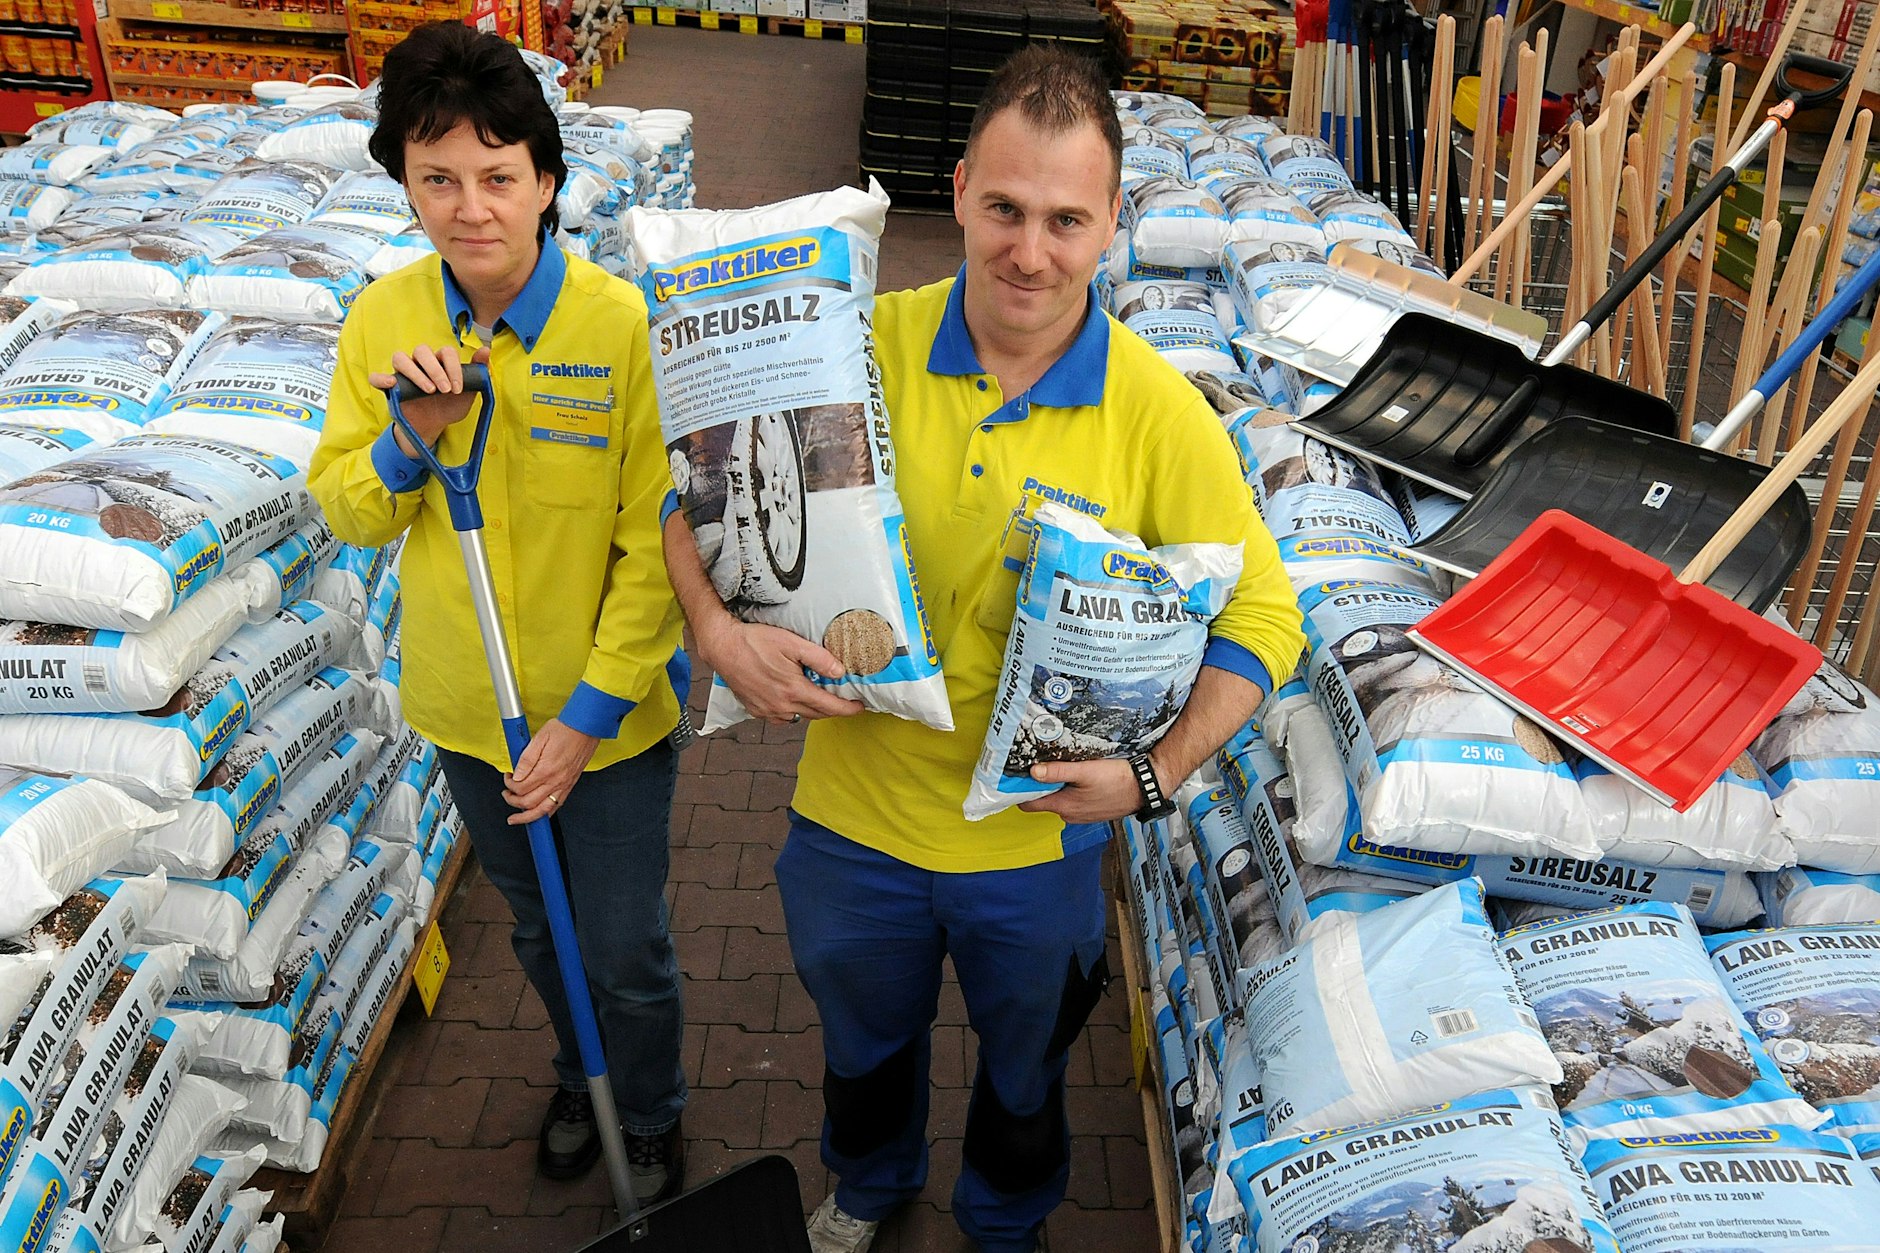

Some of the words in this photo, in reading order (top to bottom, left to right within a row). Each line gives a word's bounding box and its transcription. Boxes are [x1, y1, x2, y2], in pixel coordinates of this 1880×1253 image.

[1186, 209, 1195, 217] KG
[656, 242, 816, 298] Praktiker
[1134, 263, 1185, 280] Praktiker
[660, 293, 821, 357] STREUSALZ
[2, 319, 42, 367] GRANULAT
[663, 352, 706, 377] AUSREICHEND
[707, 346, 722, 359] FÜR
[725, 345, 739, 354] BIS
[742, 341, 753, 351] ZU
[755, 336, 777, 348] 2500
[2, 372, 86, 389] GRANUL
[531, 362, 611, 378] Praktiker
[689, 379, 712, 393] Wirkung
[713, 373, 731, 385] durch
[732, 366, 765, 379] spezielles
[766, 356, 824, 372] Mischverhältnis
[695, 368, 712, 380] gegen
[710, 387, 720, 395] bei
[721, 381, 750, 393] dickeren
[751, 378, 764, 386] Eis-
[765, 374, 780, 383] und
[781, 370, 811, 381] Schnee-
[94, 376, 149, 401] LAVA
[692, 400, 709, 411] durch
[710, 394, 728, 407] grobe
[729, 389, 756, 400] Kristalle
[175, 397, 304, 420] Praktiker
[152, 440, 272, 480] GRANULAT
[246, 491, 294, 531] GRANULAT
[1022, 476, 1107, 518] Praktiker
[27, 512, 47, 523] 20
[50, 515, 71, 529] KG
[1291, 515, 1408, 547] STREUSALZ
[175, 545, 220, 592] Praktiker
[1059, 588, 1124, 623] LAVA
[1055, 621, 1114, 639] AUSREICHEND
[1058, 637, 1118, 654] Umweltfreundlich
[0, 658, 66, 680] NULAT
[245, 665, 271, 700] LAVA
[271, 633, 317, 677] GRANULAT
[1053, 656, 1113, 674] Wiederverwertbar
[1056, 647, 1090, 662] Verringert
[27, 686, 48, 699] 20
[51, 686, 75, 700] KG
[1320, 660, 1361, 750] STREUSALZ
[201, 702, 245, 759] Praktiker
[278, 739, 302, 772] LAVA
[301, 700, 344, 749] GRANULAT
[1461, 744, 1481, 759] 25
[1485, 746, 1505, 762] KG
[1856, 762, 1875, 775] 25
[19, 787, 35, 801] 20
[35, 781, 52, 795] KG
[236, 775, 278, 834] Praktiker
[310, 768, 350, 823] GRANULAT
[1252, 801, 1292, 897] STREUSALZ
[1355, 834, 1466, 867] Praktiker
[1509, 856, 1657, 895] STREUSALZ
[1609, 893, 1627, 905] 25
[324, 932, 342, 965] LAVA
[341, 875, 377, 933] GRANULAT
[1530, 921, 1680, 956] GRANULAT
[1718, 939, 1795, 973] LAVA
[1798, 935, 1880, 951] GRAN
[1520, 961, 1537, 973] FÜR
[1539, 957, 1553, 966] BIS
[1570, 950, 1586, 958] 200
[1731, 960, 1793, 984] AUSREICHEND
[1814, 953, 1829, 961] BIS
[1741, 968, 1803, 991] Umweltfreundlich
[20, 1031, 56, 1094] LAVA
[51, 927, 115, 1032] GRANULAT
[352, 1020, 370, 1056] LAVA
[368, 959, 399, 1022] GRANULAT
[139, 1019, 152, 1043] KG
[54, 1105, 90, 1167] LAVA
[85, 998, 145, 1107] GRANULAT
[1278, 1102, 1295, 1125] KG
[1620, 1103, 1636, 1117] 10
[1638, 1103, 1655, 1115] KG
[1345, 1111, 1514, 1156] GRANULAT
[1625, 1128, 1774, 1145] Praktiker
[94, 1177, 125, 1237] LAVA
[122, 1070, 174, 1177] GRANULAT
[1261, 1150, 1337, 1197] LAVA
[1270, 1172, 1330, 1211] AUSREICHEND
[1333, 1162, 1351, 1176] FÜR
[1354, 1157, 1370, 1167] BIS
[1374, 1152, 1386, 1160] ZU
[1389, 1146, 1407, 1156] 200
[1678, 1159, 1853, 1187] GRANULAT
[1277, 1180, 1339, 1219] Umweltfreundlich
[1281, 1200, 1315, 1227] Verringert
[1316, 1193, 1327, 1204] die
[1328, 1182, 1352, 1201] Gefahr
[1355, 1176, 1369, 1186] von
[1370, 1155, 1426, 1179] überfrierender
[1284, 1193, 1346, 1238] Wiederverwertbar
[1347, 1187, 1359, 1198] zur
[1360, 1160, 1437, 1191] Bodenauflockerung
[1451, 1152, 1478, 1163] Garten
[1671, 1192, 1691, 1202] FÜR
[1695, 1193, 1712, 1202] BIS
[1714, 1193, 1728, 1201] ZU
[1732, 1192, 1751, 1201] 200
[22, 1181, 58, 1253] ktiker
[1613, 1210, 1680, 1234] mweltfreundlich
[1654, 1223, 1667, 1233] die
[1669, 1219, 1697, 1230] Gefahr
[1699, 1219, 1715, 1228] von
[1716, 1217, 1775, 1227] überfrierender
[1777, 1218, 1803, 1226] Nässe
[1691, 1231, 1705, 1240] zur
[1708, 1227, 1788, 1240] Bodenauflockerung
[1789, 1229, 1800, 1237] im
[1802, 1228, 1831, 1238] Garten
